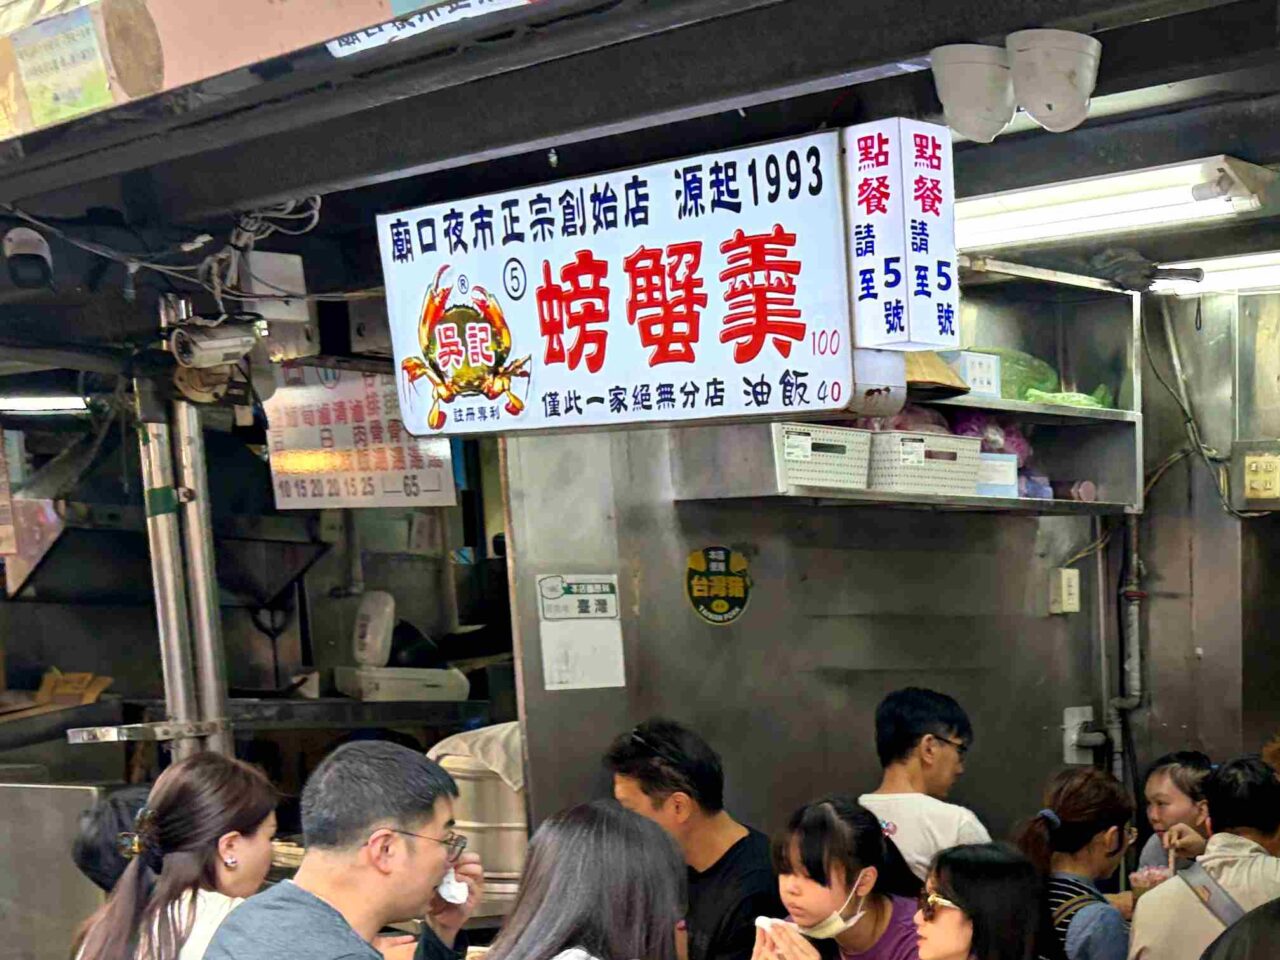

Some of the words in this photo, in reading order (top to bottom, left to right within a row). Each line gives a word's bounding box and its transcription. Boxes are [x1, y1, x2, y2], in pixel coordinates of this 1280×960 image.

[391, 175, 650, 263] 廟口夜市正宗創始店
[673, 145, 824, 222] 源起1993
[857, 132, 891, 216] 點餐
[913, 133, 943, 217] 點餐
[534, 222, 807, 374] 螃蟹羹
[811, 326, 841, 357] 100
[541, 380, 726, 419] 僅此一家絕無分店
[743, 368, 812, 408] 油飯
[816, 381, 843, 404] 40
